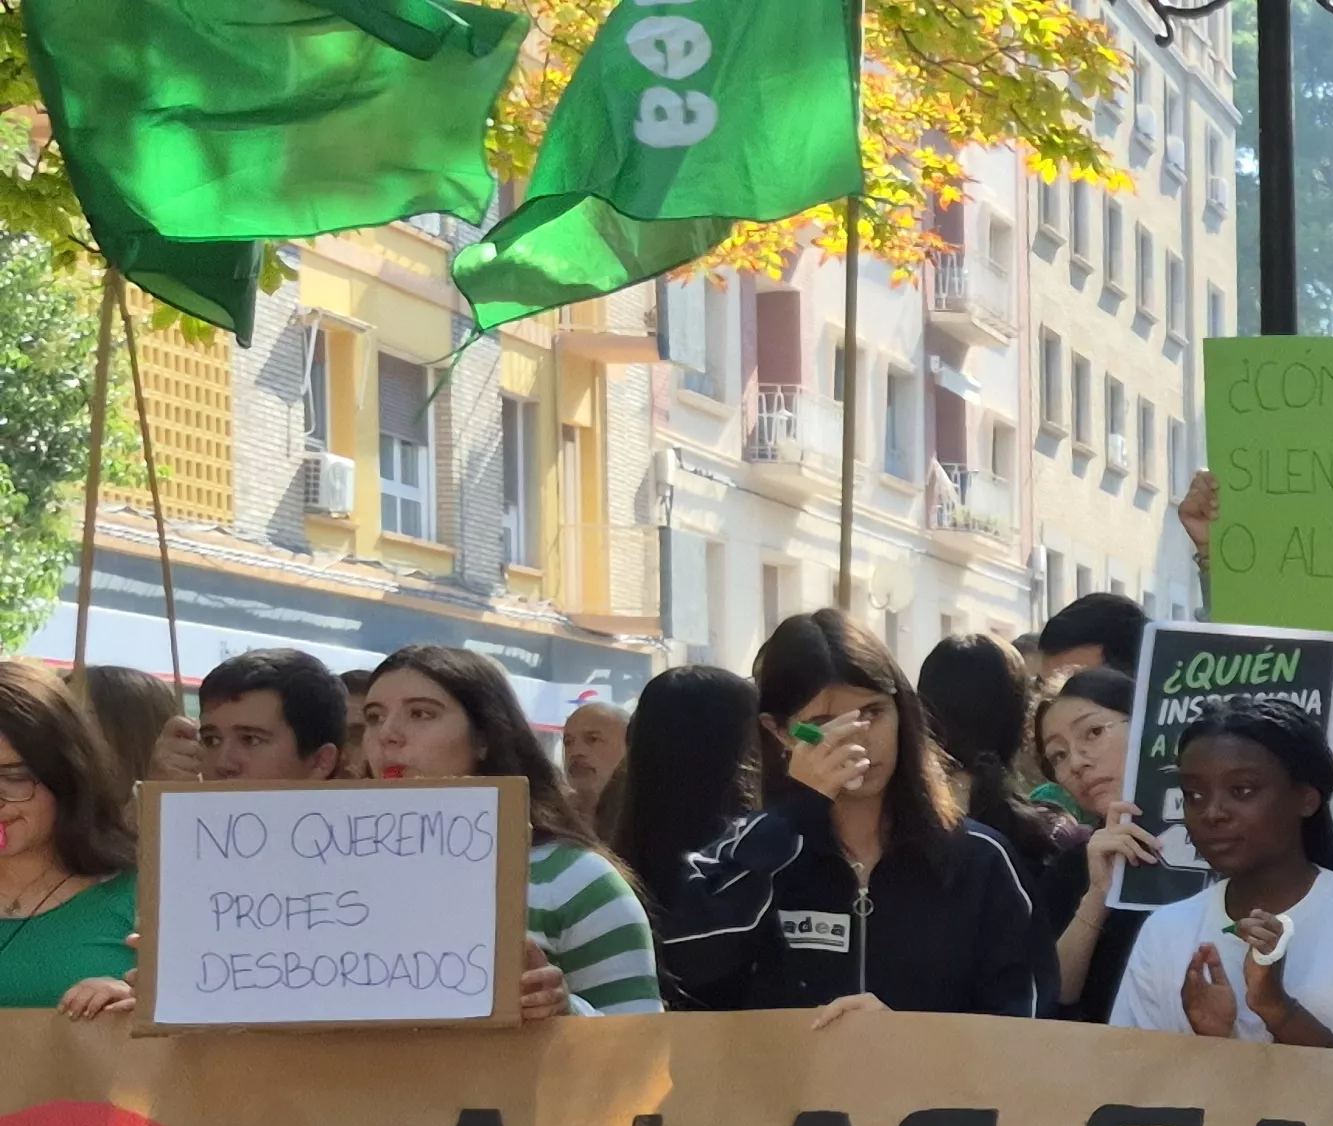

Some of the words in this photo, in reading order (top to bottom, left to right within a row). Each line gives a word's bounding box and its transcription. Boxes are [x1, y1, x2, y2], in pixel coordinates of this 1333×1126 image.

[1219, 523, 1255, 574] O
[1163, 645, 1302, 694] ¿QUIÉN
[195, 812, 267, 860] NO
[291, 810, 495, 865] QUEREMOS
[211, 890, 370, 934] PROFES
[783, 916, 846, 937] adea
[199, 943, 490, 997] DESBORDADOS
